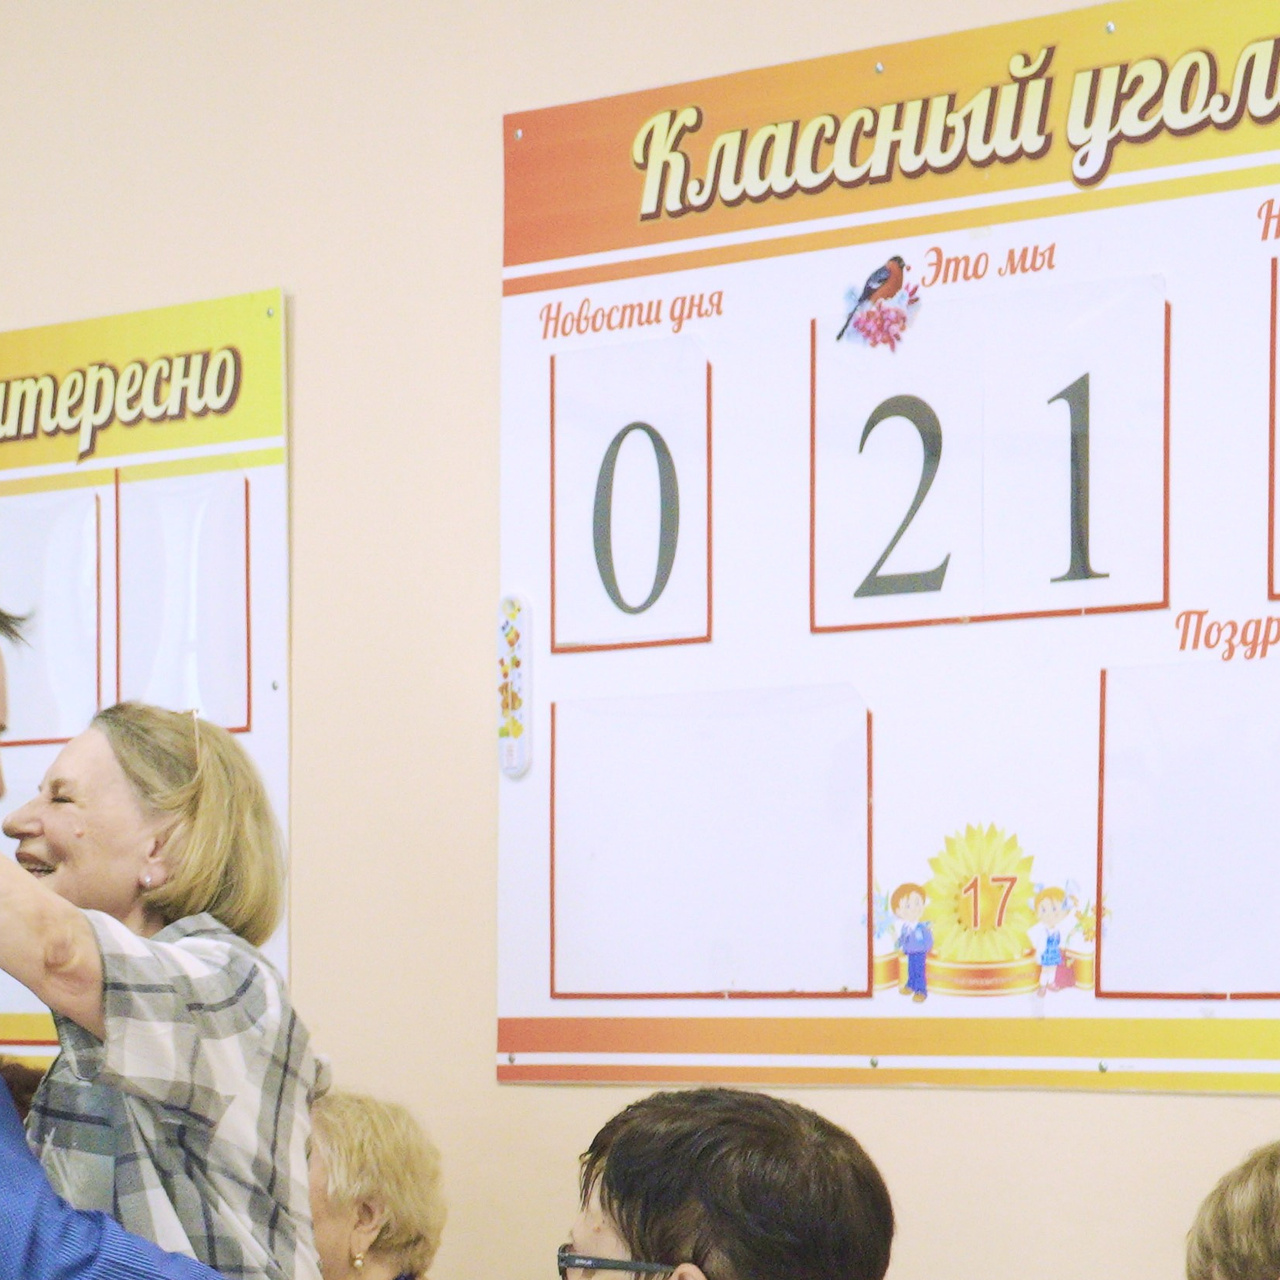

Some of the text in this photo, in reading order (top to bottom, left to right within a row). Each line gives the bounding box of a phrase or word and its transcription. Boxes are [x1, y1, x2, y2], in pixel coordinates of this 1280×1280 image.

[632, 46, 1056, 222] Классный
[921, 241, 1057, 289] Это мы
[539, 290, 724, 341] Новости дня
[962, 874, 1018, 930] 17
